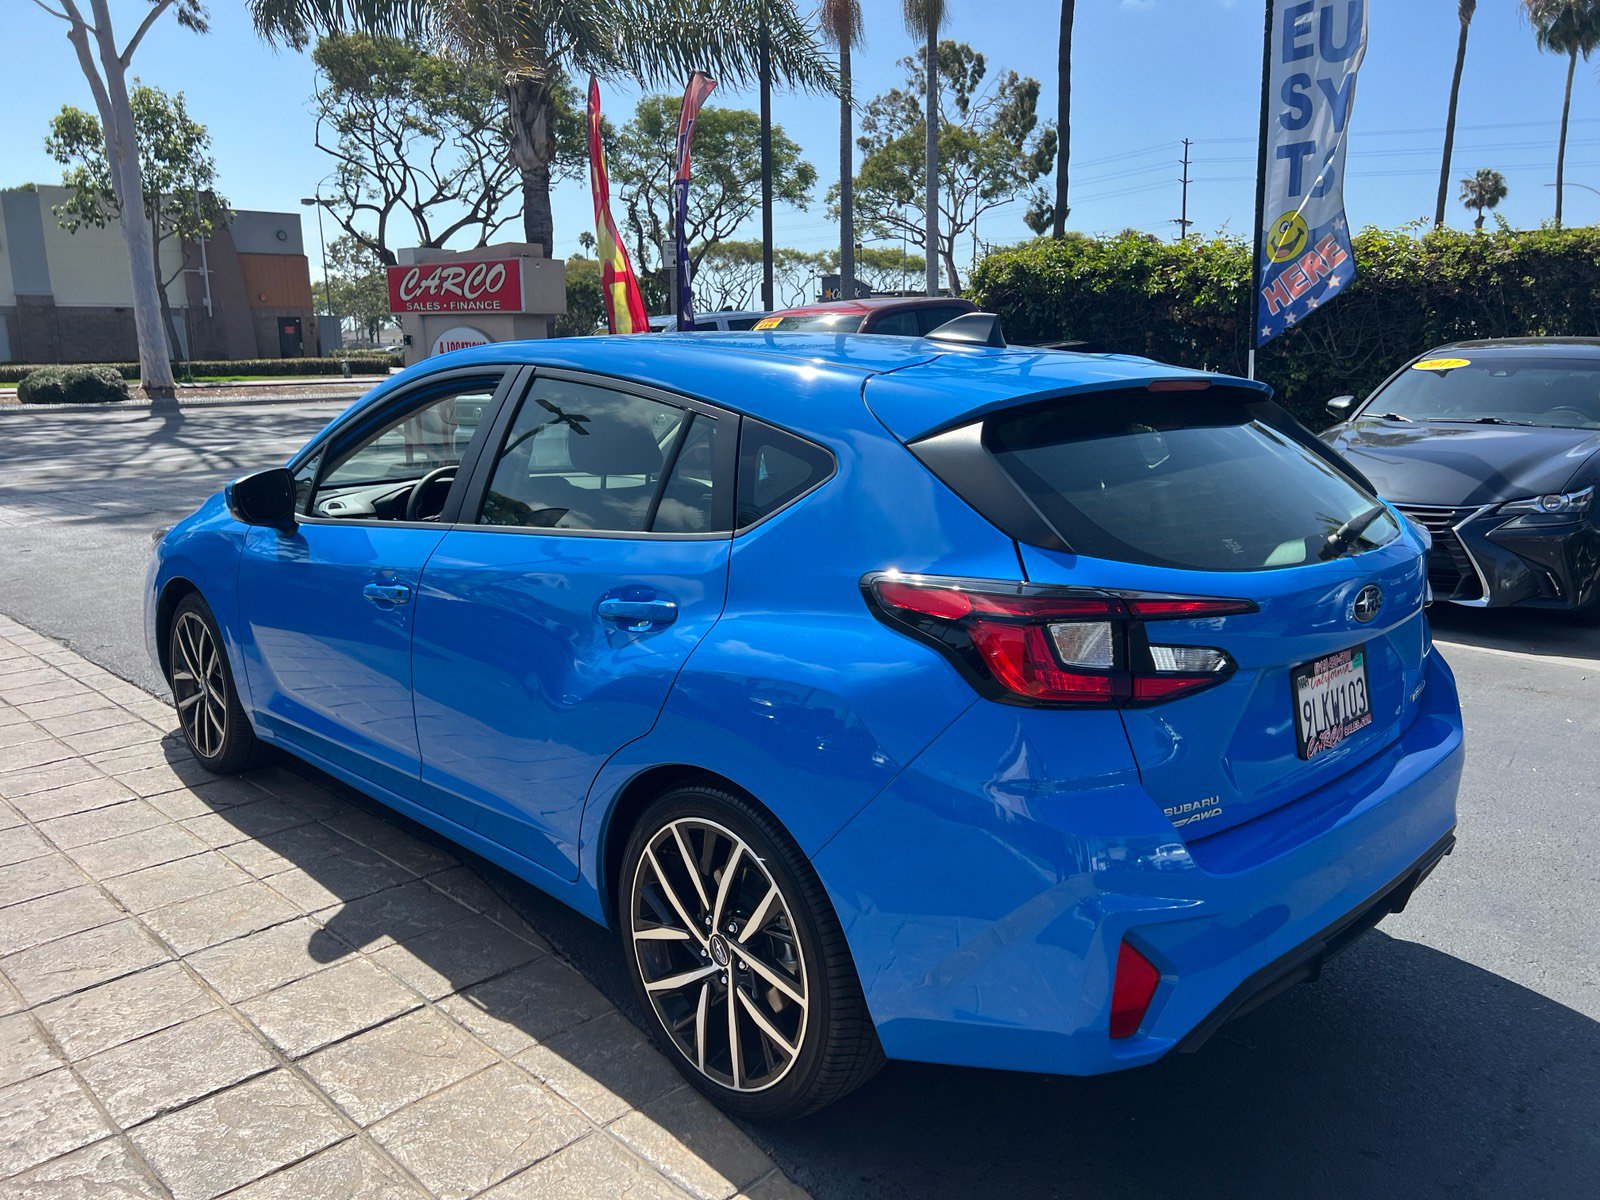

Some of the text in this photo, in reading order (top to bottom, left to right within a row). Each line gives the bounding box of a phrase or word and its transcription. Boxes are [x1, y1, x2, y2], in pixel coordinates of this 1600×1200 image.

[399, 262, 506, 301] CARCO
[1261, 232, 1348, 316] HERE
[406, 301, 500, 311] SALES FINANCE
[1303, 677, 1367, 739] 9LKW103
[1163, 795, 1219, 817] SUBARU
